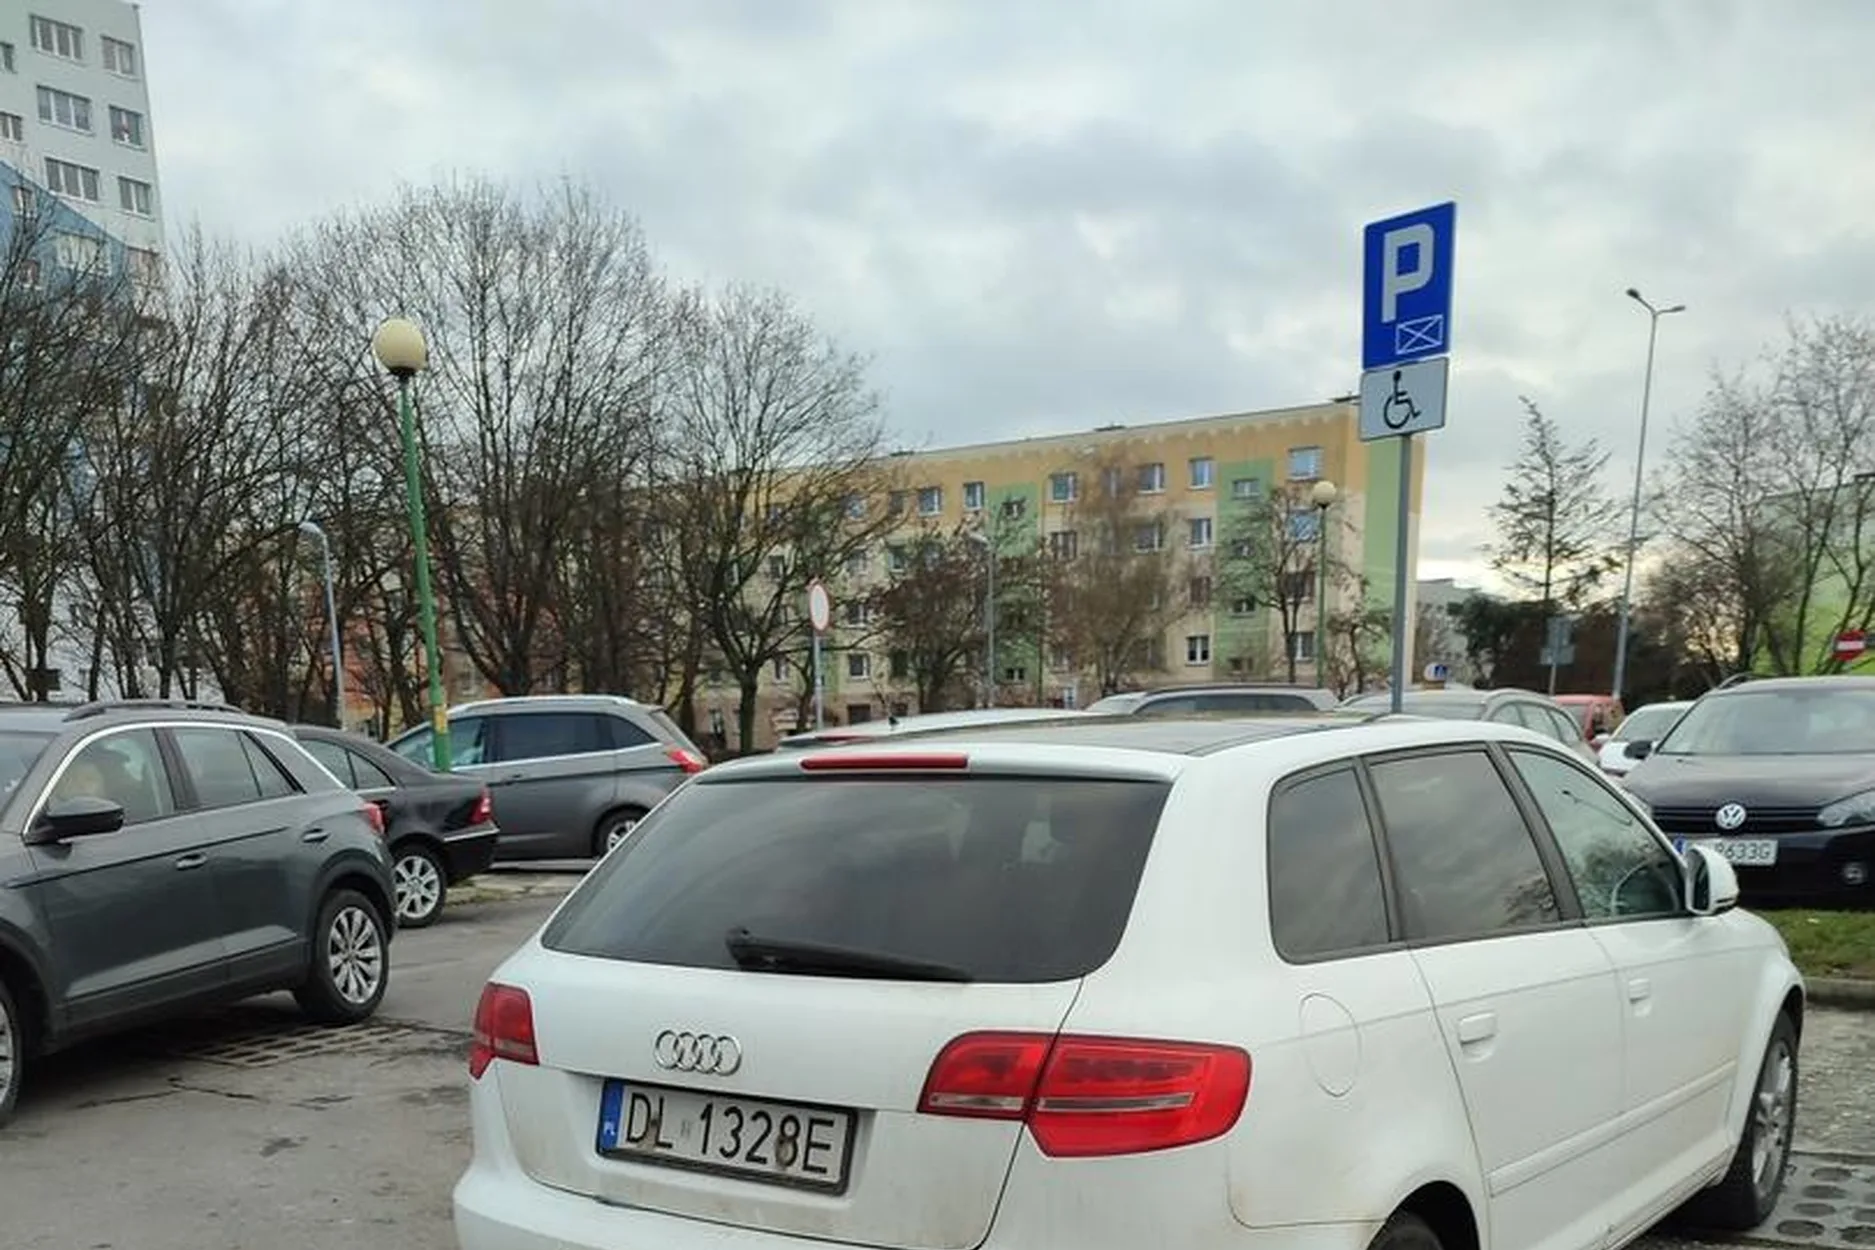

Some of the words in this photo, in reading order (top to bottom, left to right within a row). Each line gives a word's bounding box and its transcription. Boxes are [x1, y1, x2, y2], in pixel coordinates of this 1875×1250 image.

[1381, 223, 1434, 323] P
[626, 1092, 673, 1149] DL
[700, 1102, 834, 1174] 1328E
